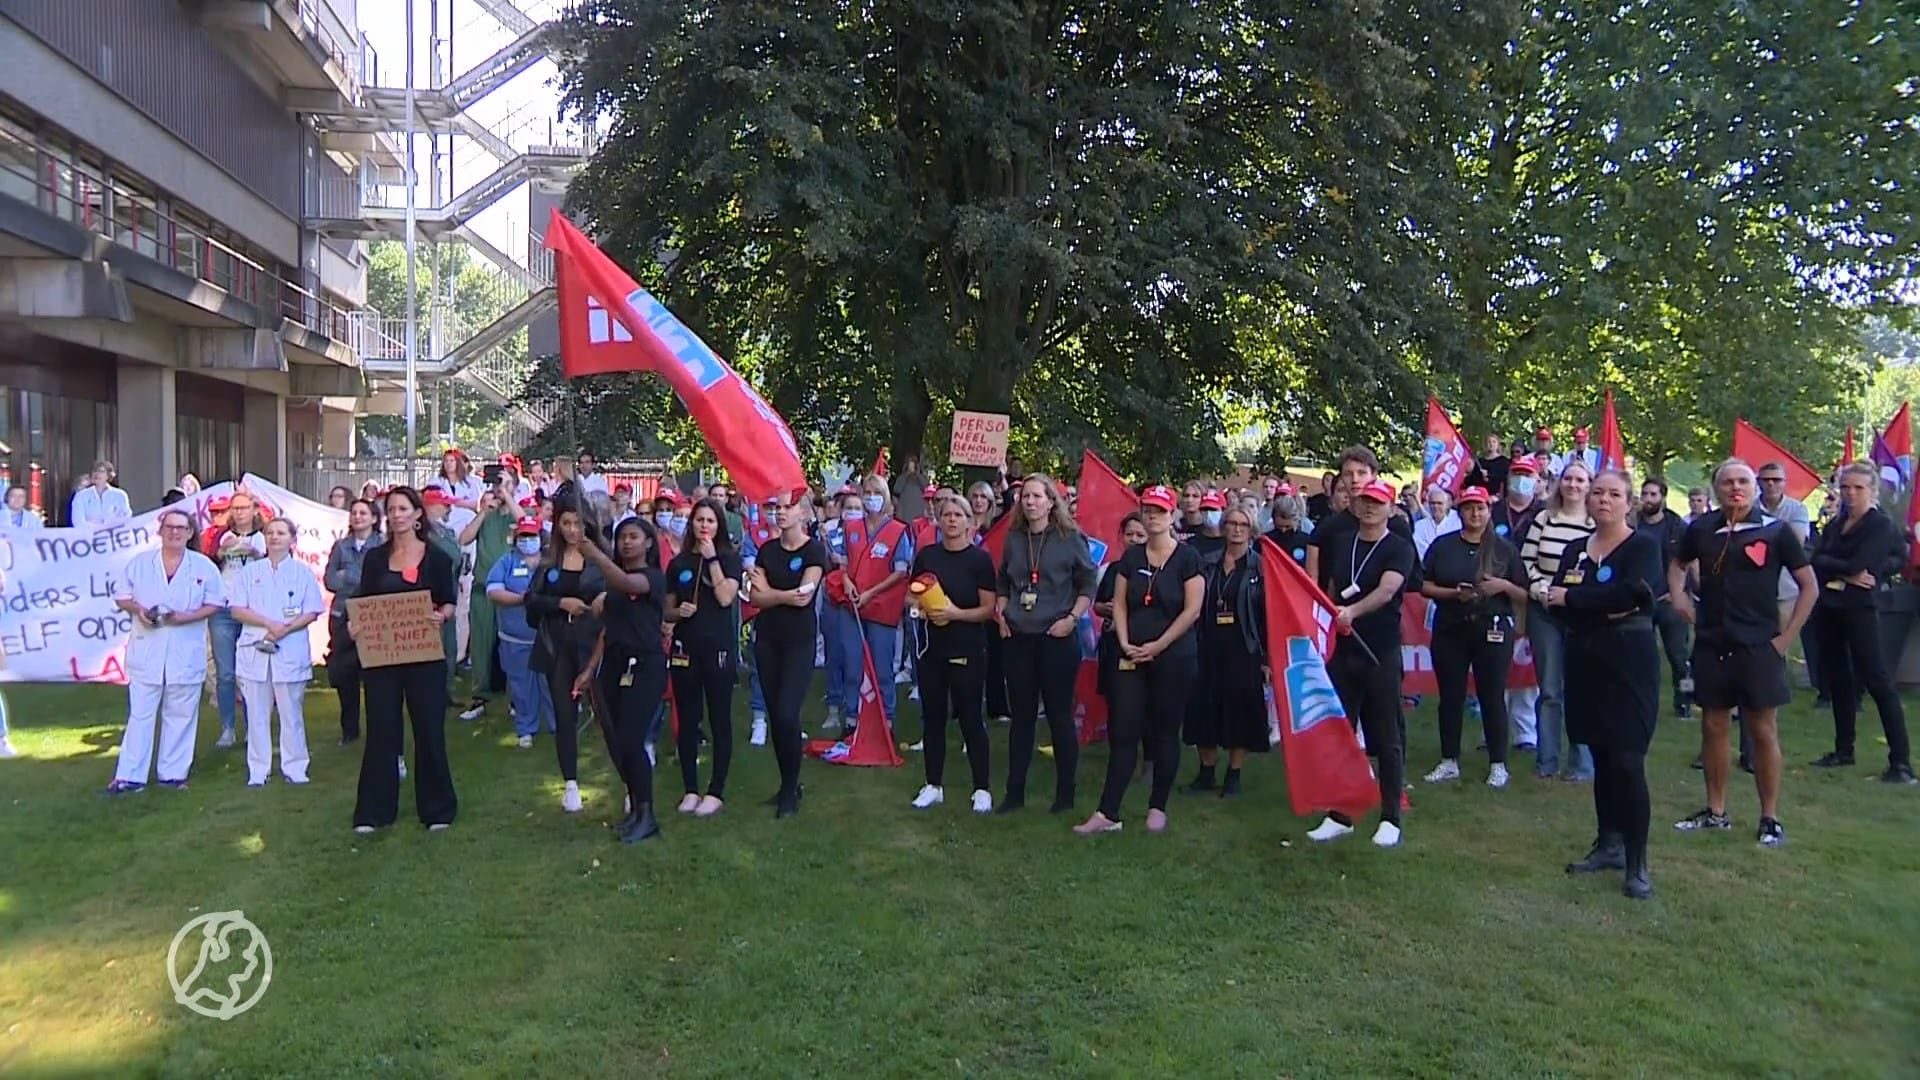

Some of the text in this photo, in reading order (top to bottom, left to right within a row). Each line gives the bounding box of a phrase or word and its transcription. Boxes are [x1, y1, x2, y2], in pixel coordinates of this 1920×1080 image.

[960, 418, 1005, 432] PERSO
[954, 431, 986, 443] NEEL
[953, 442, 997, 454] BEHOUD
[394, 627, 430, 642] NIET
